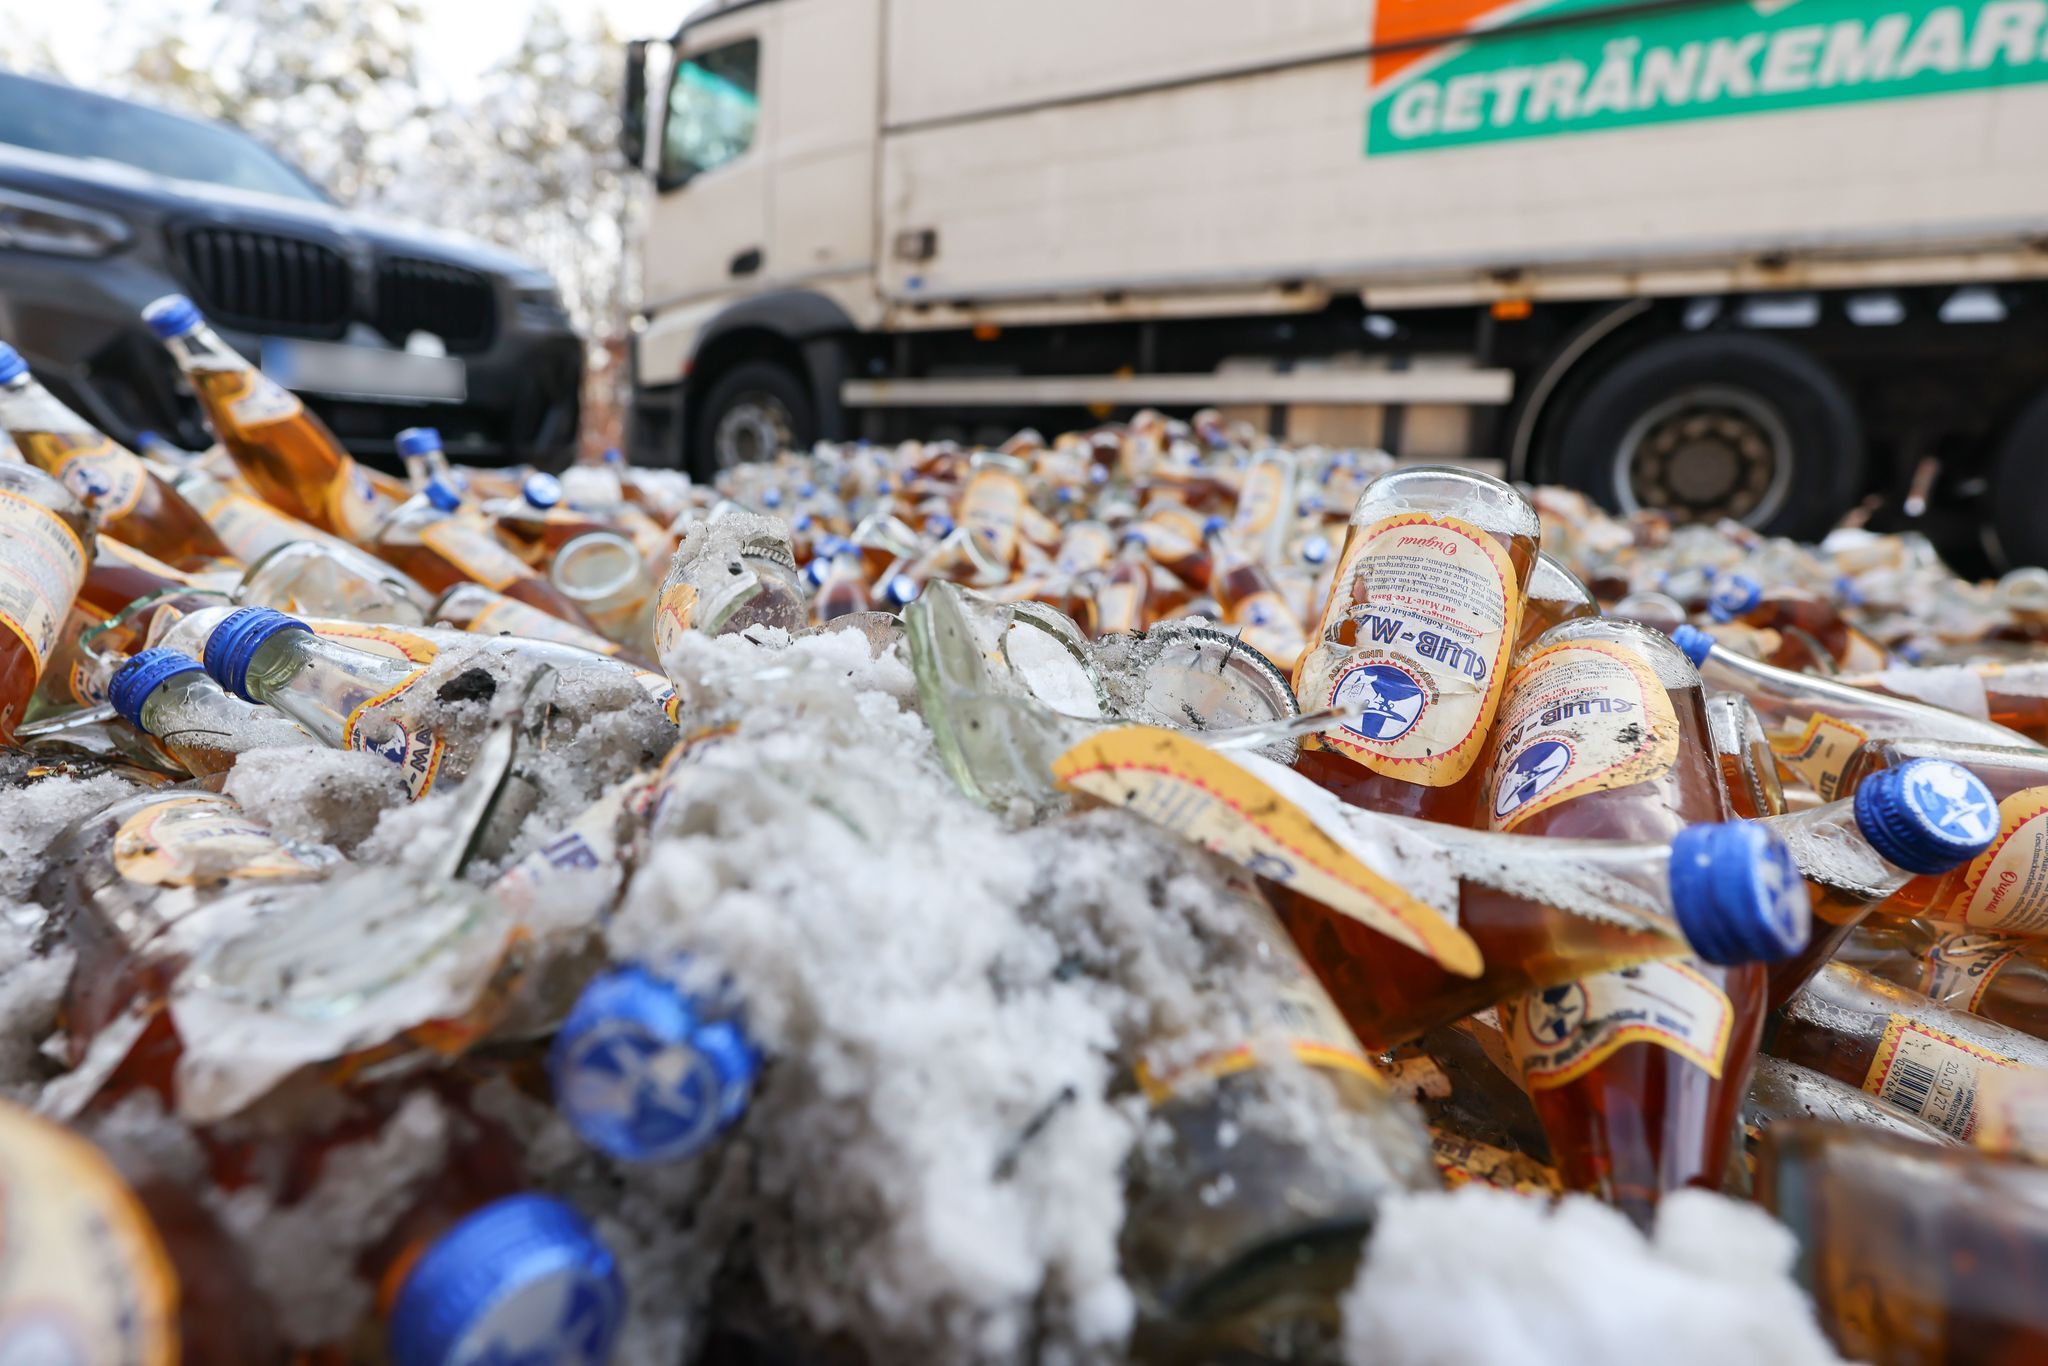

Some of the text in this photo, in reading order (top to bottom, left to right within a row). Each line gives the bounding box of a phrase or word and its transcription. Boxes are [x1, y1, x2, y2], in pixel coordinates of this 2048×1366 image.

[1387, 0, 2048, 139] GETRÄNKEMAR
[1397, 535, 1456, 556] Original
[1391, 607, 1443, 630] Koffeingehalt
[1440, 604, 1456, 613] auf
[1359, 649, 1382, 659] UND
[1983, 868, 2018, 914] Original
